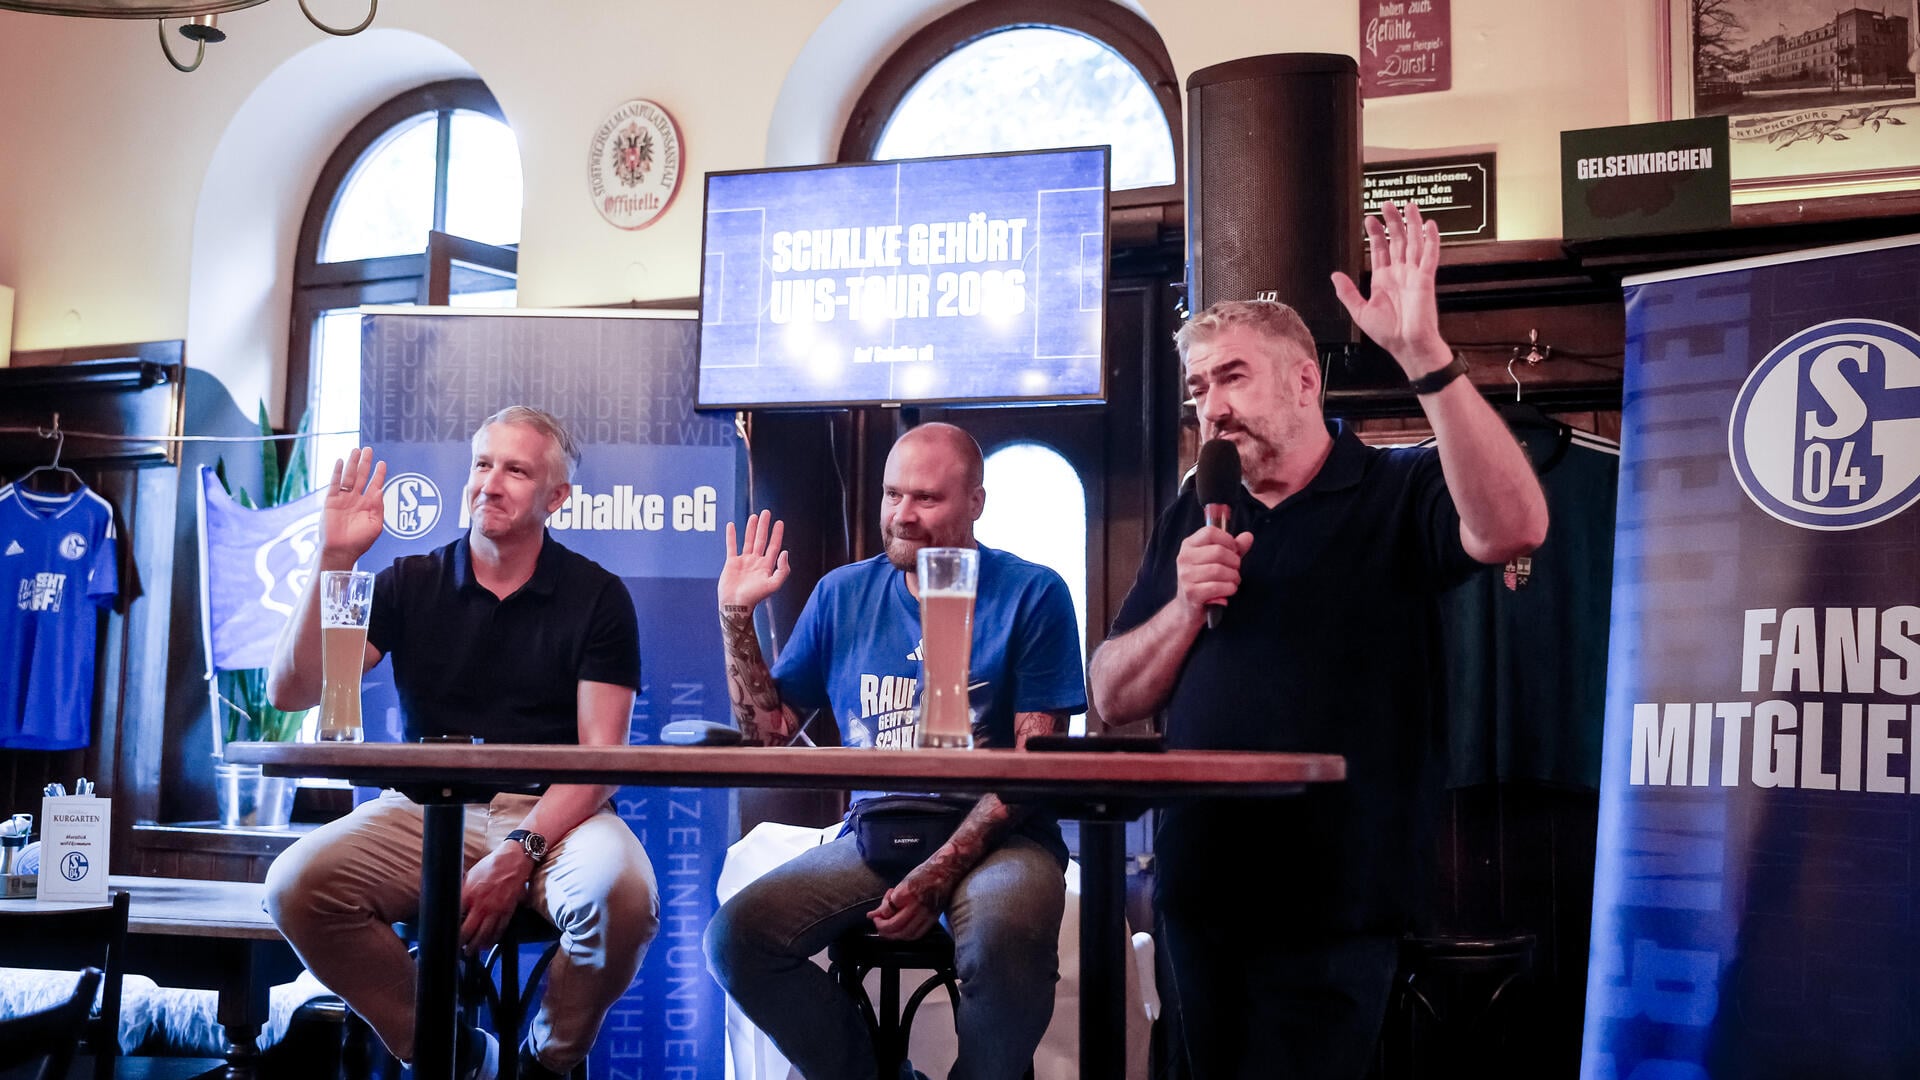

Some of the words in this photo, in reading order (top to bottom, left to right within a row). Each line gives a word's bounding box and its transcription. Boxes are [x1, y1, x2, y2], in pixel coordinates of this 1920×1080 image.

[1378, 175, 1404, 187] zwei
[1405, 172, 1472, 184] Situationen,
[1577, 147, 1713, 181] GELSENKIRCHEN
[1417, 186, 1429, 195] in
[1430, 184, 1452, 194] den
[771, 224, 903, 273] SCHALKE
[907, 211, 1028, 266] GEHÖRT
[769, 274, 931, 325] UNS-TOUR
[546, 484, 665, 531] chalke
[672, 485, 717, 532] eG
[1740, 605, 1920, 696] FANS
[860, 674, 918, 719] RAUF
[878, 709, 914, 731] GEHT'S
[1629, 700, 1920, 794] MITGLIE
[53, 814, 100, 823] KURGARTEN
